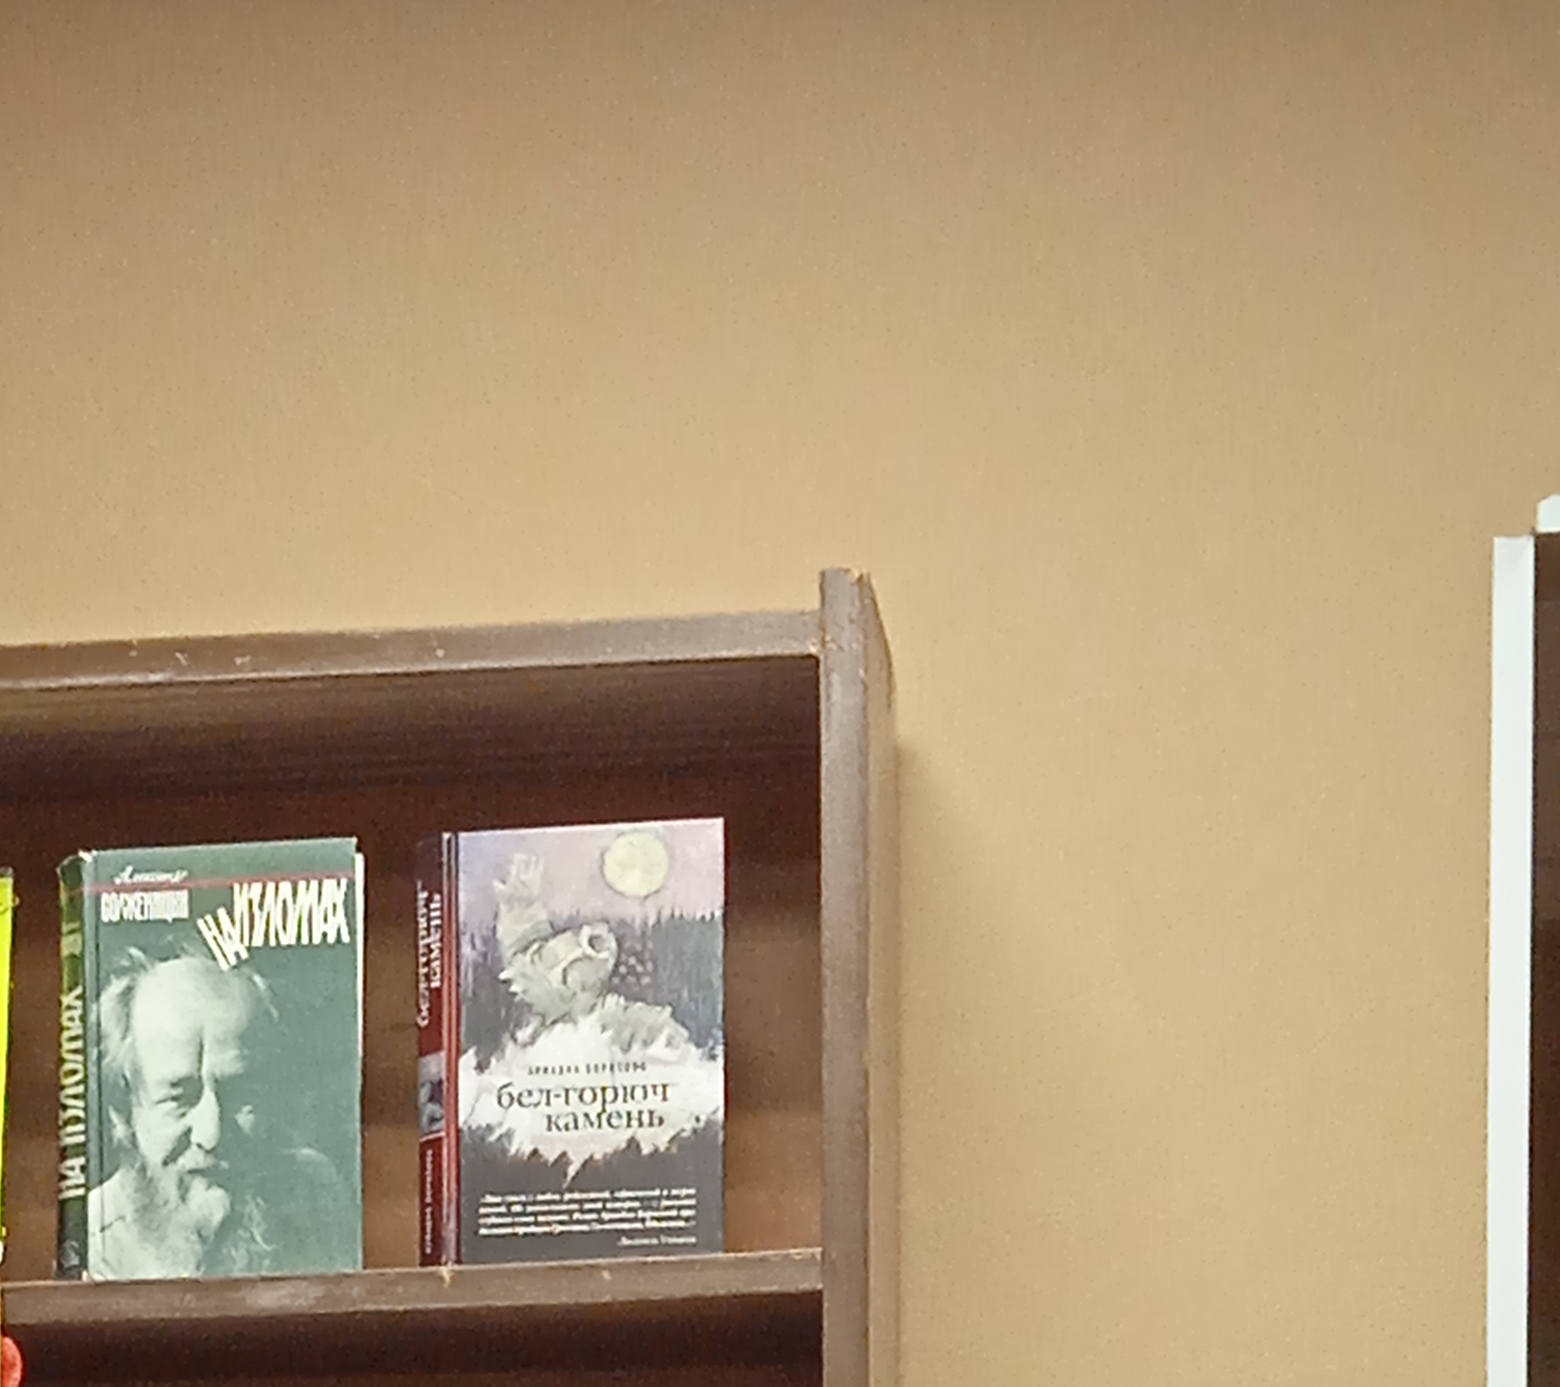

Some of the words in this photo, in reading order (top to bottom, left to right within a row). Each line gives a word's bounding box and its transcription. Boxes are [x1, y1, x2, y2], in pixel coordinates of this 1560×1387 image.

[197, 907, 249, 971] НА
[233, 878, 351, 947] ИЗЛОМАХ
[58, 985, 86, 1147] ИЗЛОМАХ
[496, 1082, 670, 1114] бел-горюч
[545, 1109, 665, 1132] камень
